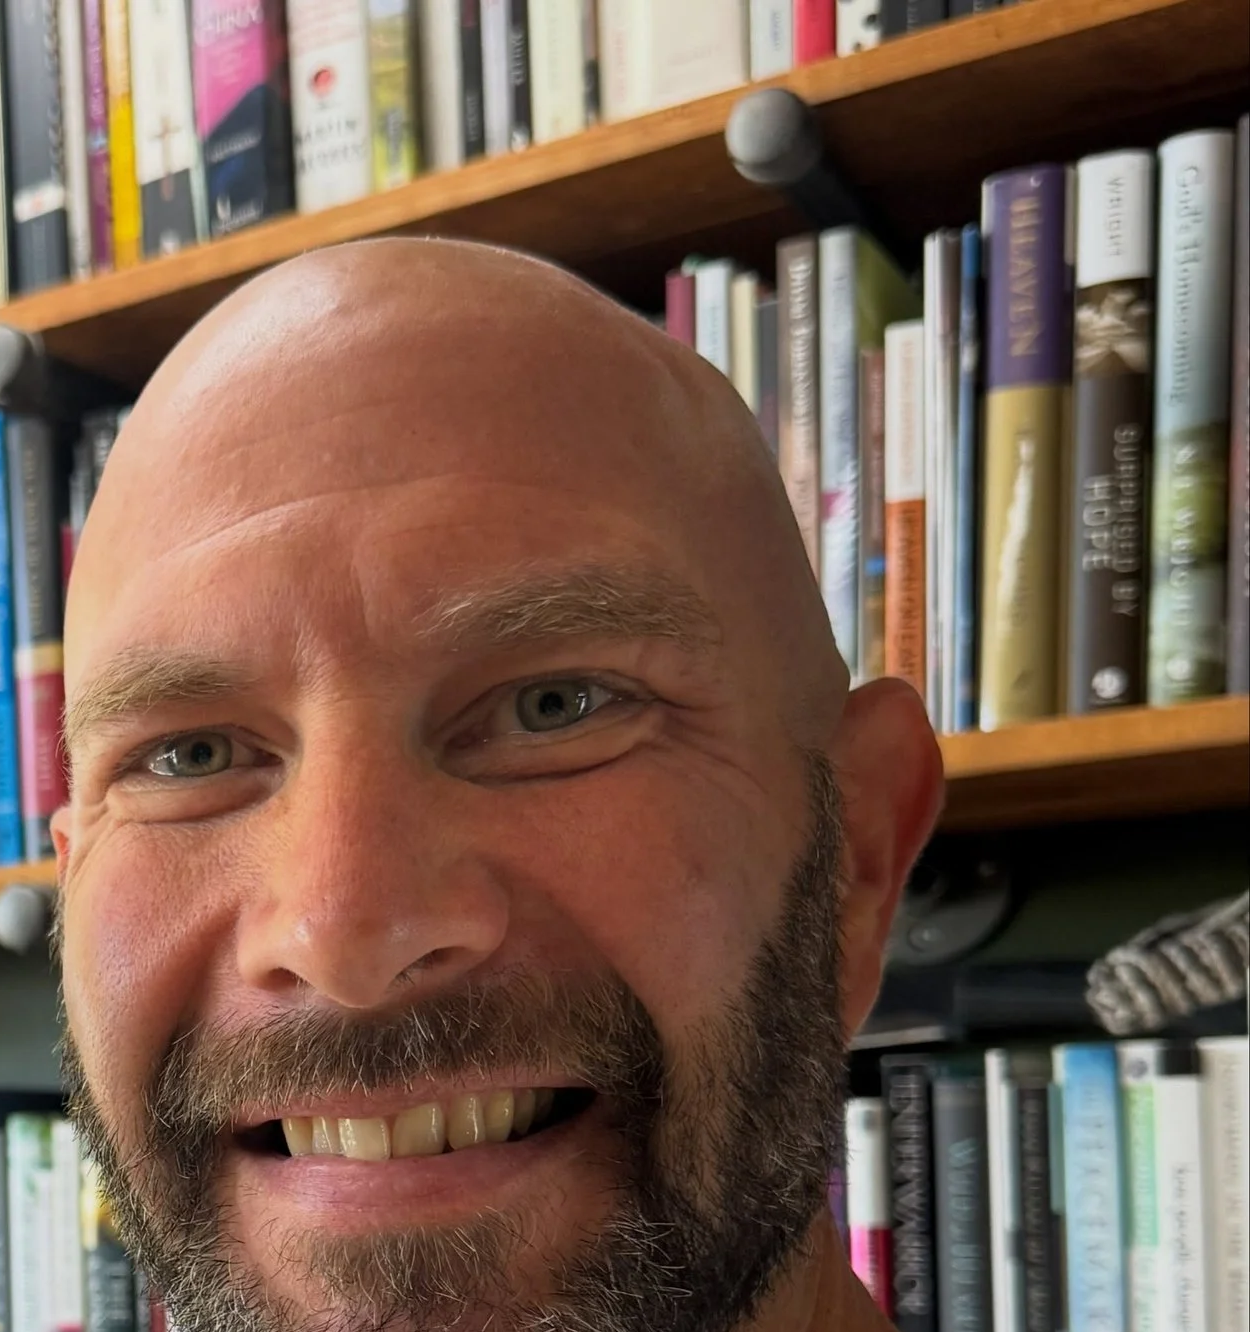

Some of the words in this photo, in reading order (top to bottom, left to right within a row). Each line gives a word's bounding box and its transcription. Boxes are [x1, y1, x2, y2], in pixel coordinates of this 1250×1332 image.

[1008, 197, 1043, 356] HEAVEN
[1081, 475, 1113, 571] HOPE
[1112, 424, 1139, 572] SURPRISED
[1111, 580, 1138, 616] BY
